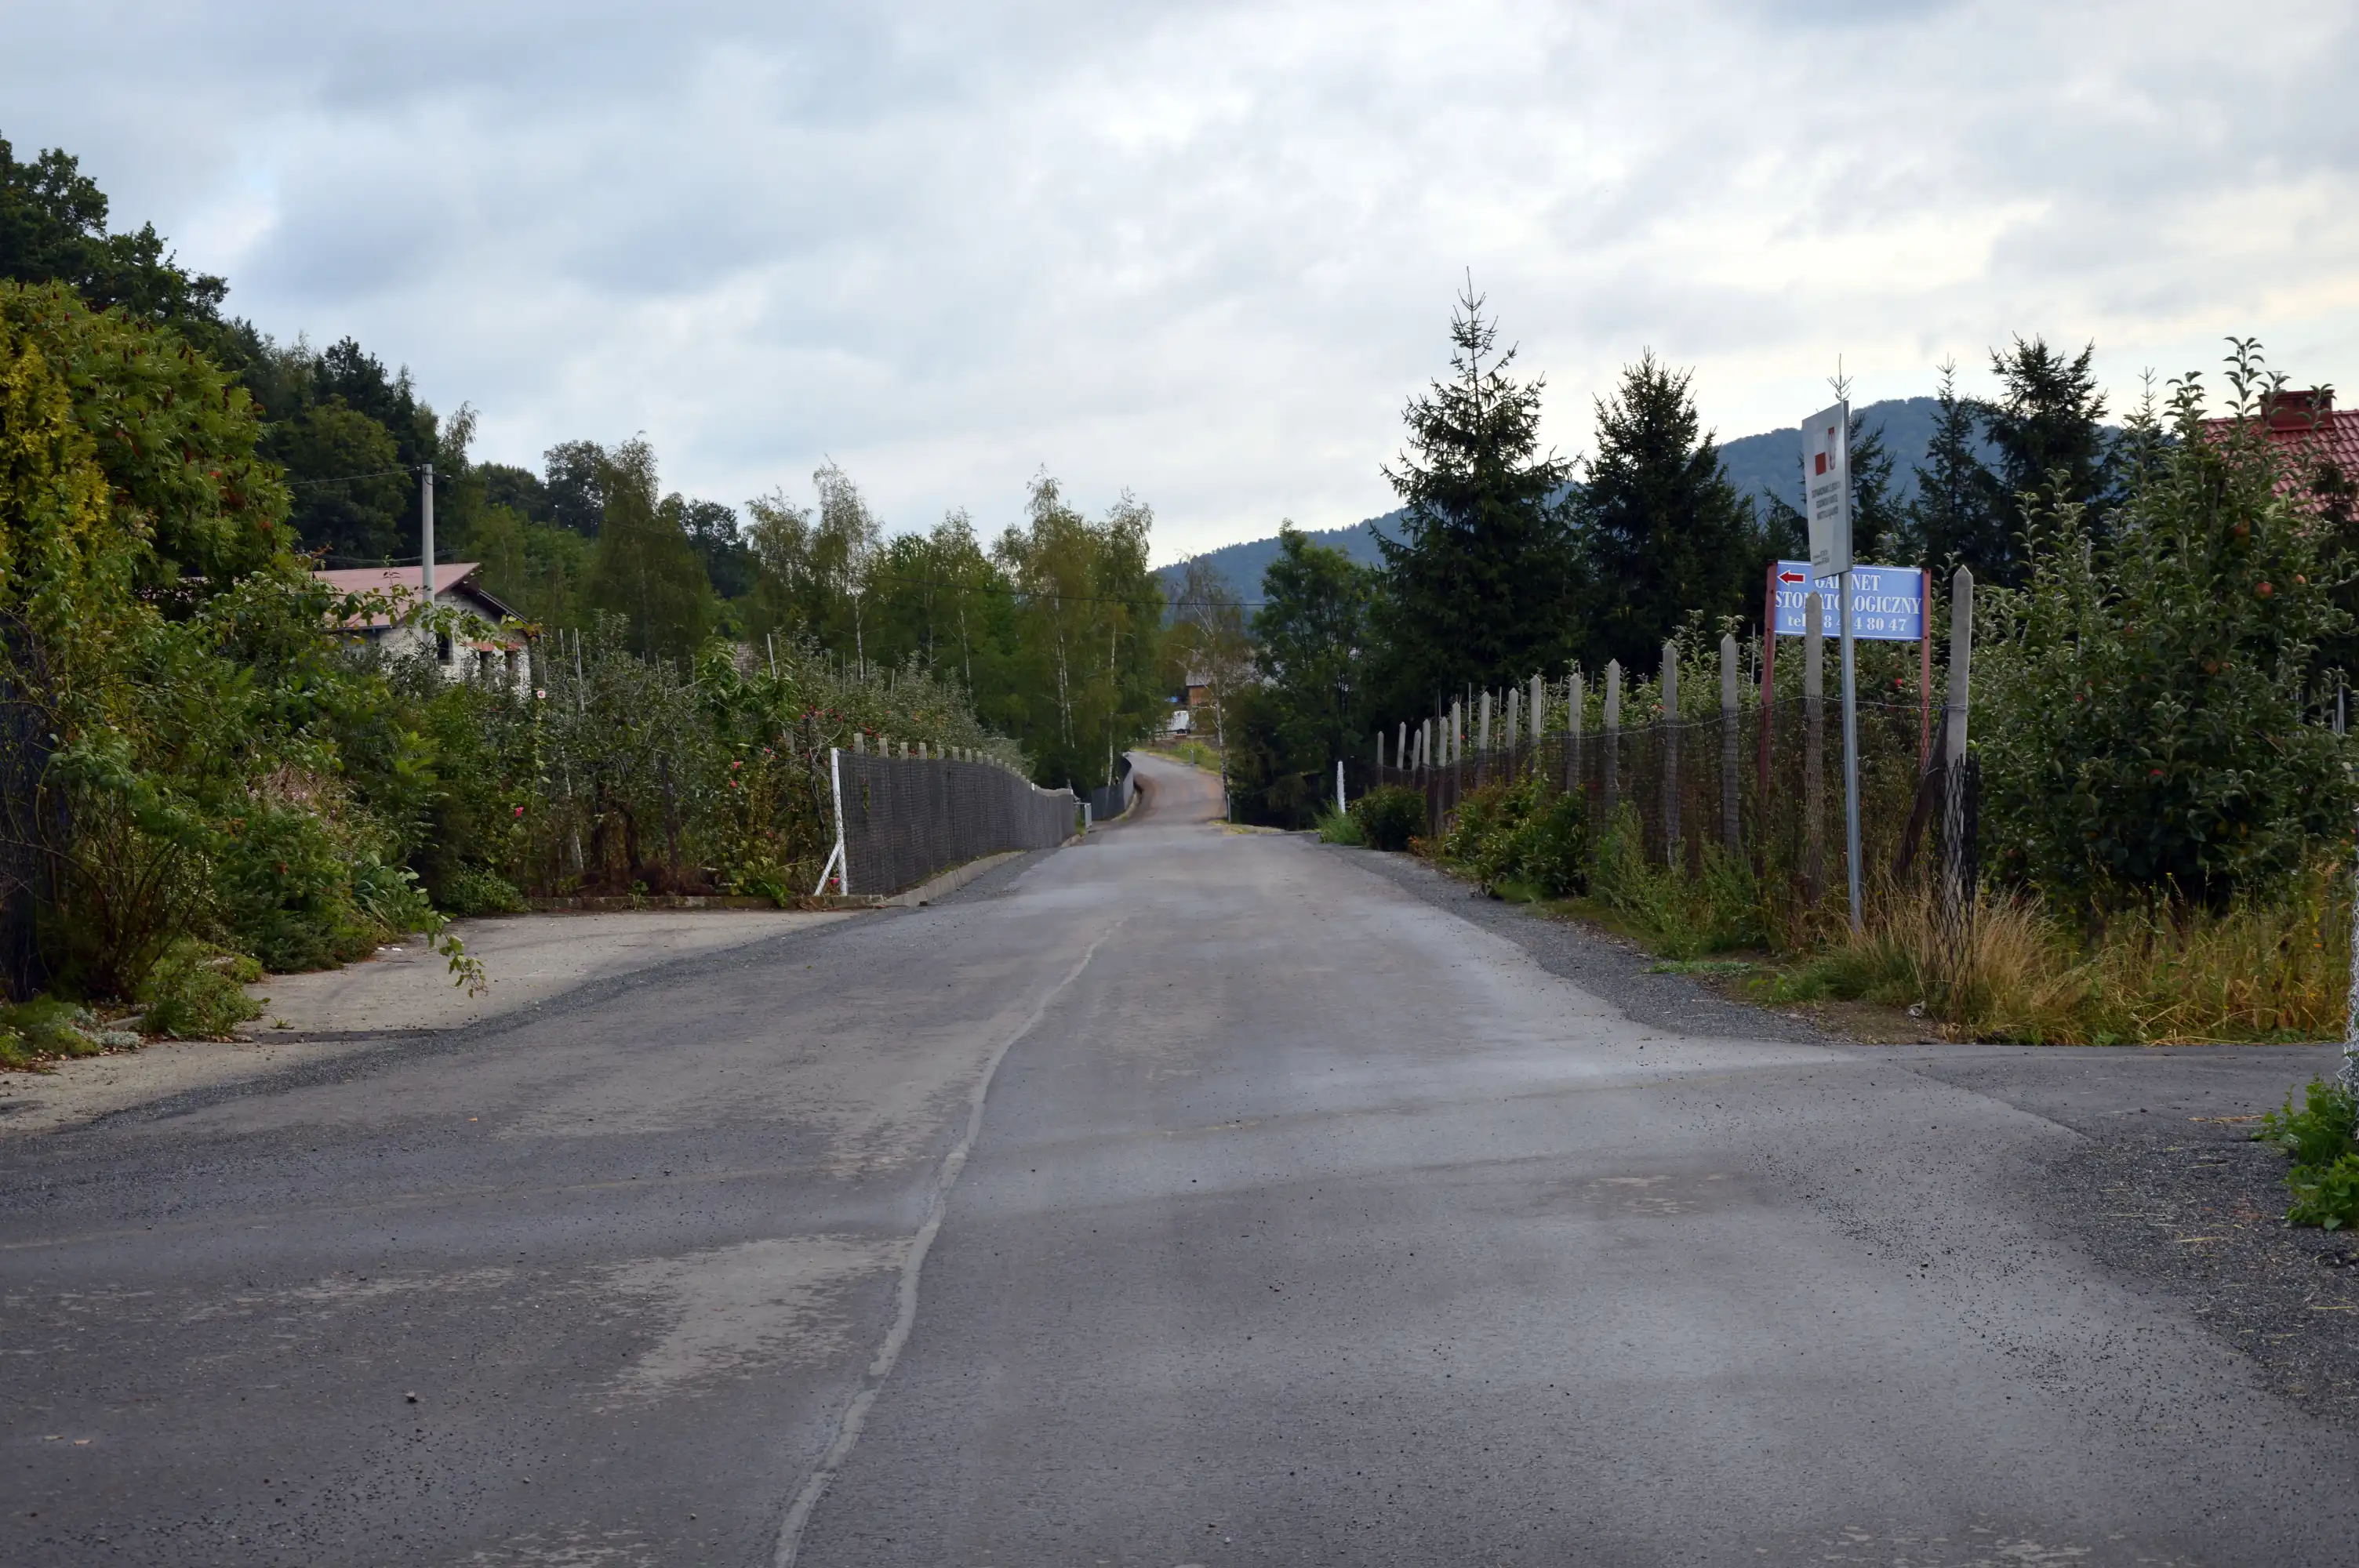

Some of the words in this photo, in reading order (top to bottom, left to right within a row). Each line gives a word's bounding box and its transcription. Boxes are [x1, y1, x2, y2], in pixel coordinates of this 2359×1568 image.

[1815, 573, 1881, 591] GANET
[1776, 590, 1922, 615] STOTOGICZNY
[1866, 617, 1885, 631] 80
[1888, 618, 1908, 632] 47
